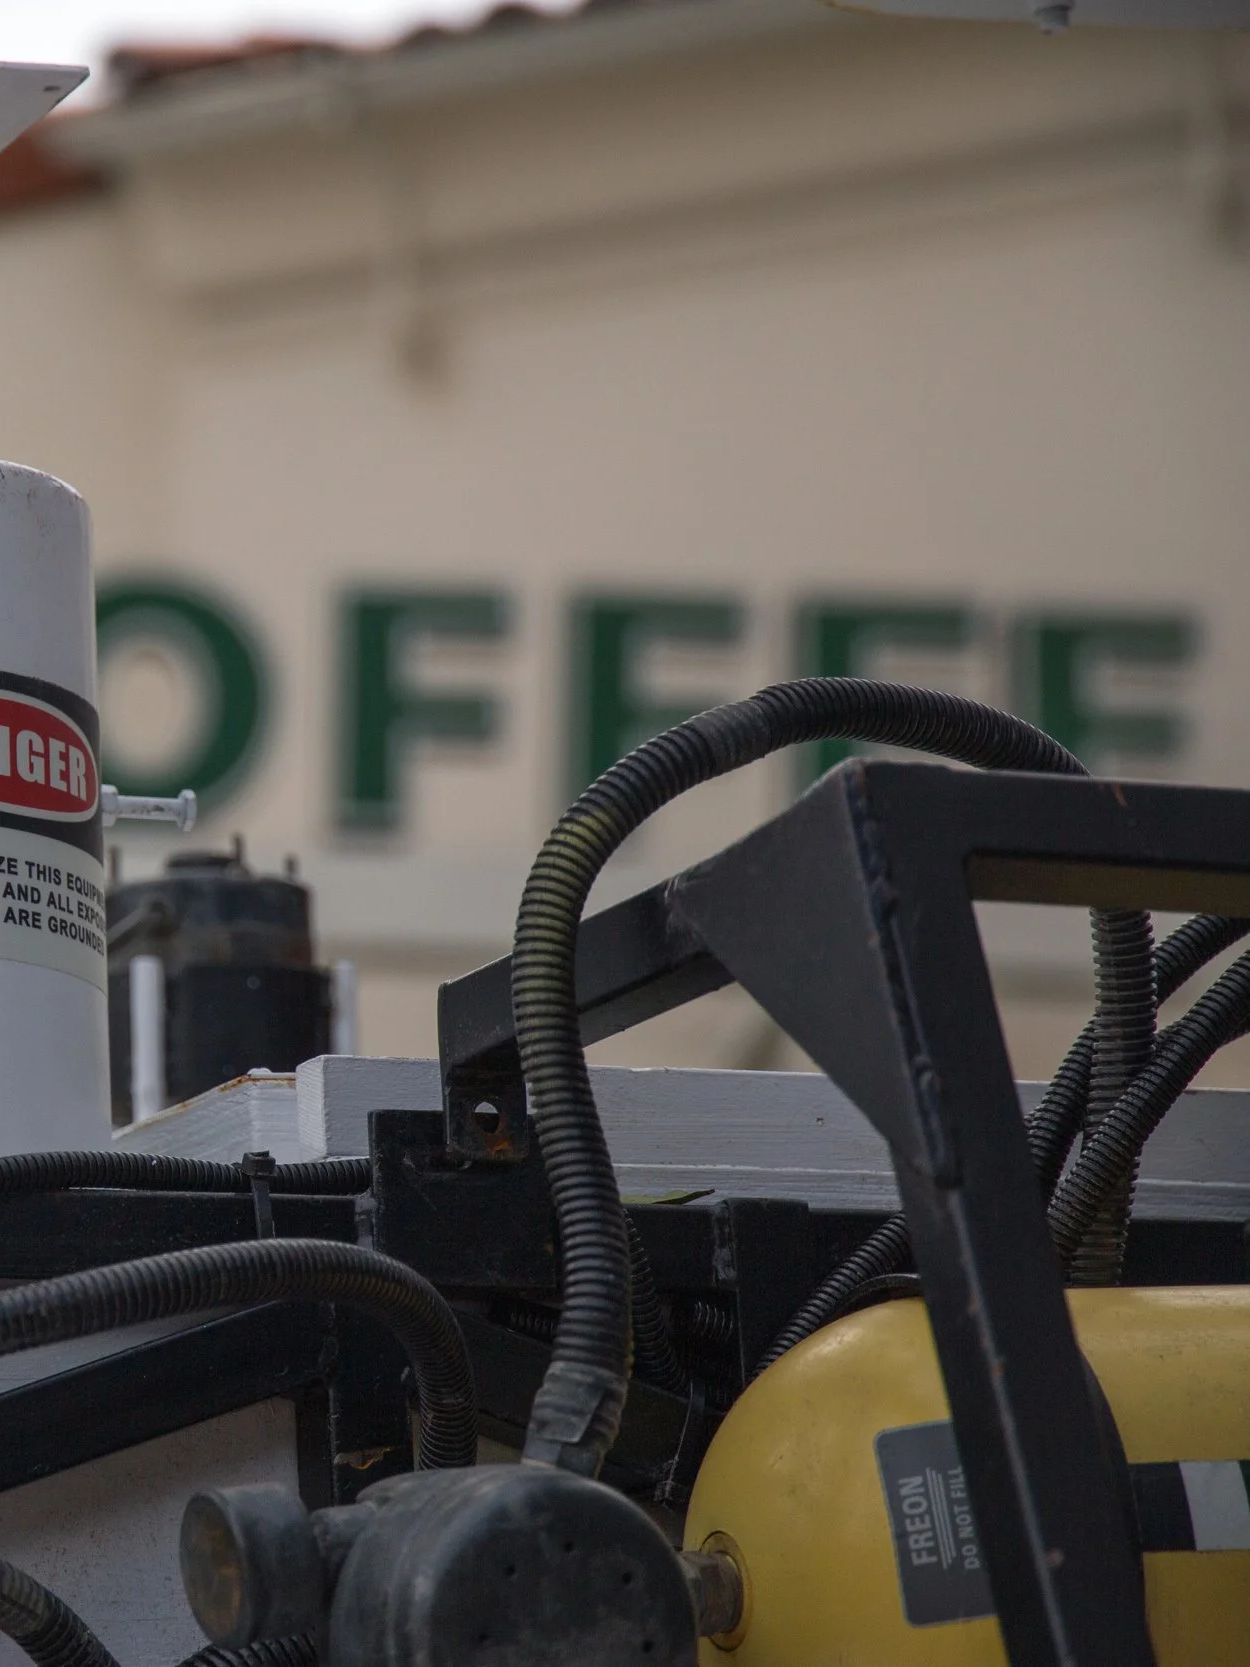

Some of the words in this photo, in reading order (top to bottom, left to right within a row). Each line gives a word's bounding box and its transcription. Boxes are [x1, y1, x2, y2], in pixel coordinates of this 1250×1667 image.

[25, 861, 62, 886] THIS
[2, 882, 41, 905] AND
[46, 891, 74, 915] ALL
[3, 907, 42, 930] ARE
[948, 1465, 967, 1500] FILL
[899, 1475, 938, 1566] FREON
[953, 1504, 974, 1540] NOT
[962, 1545, 980, 1570] DO
